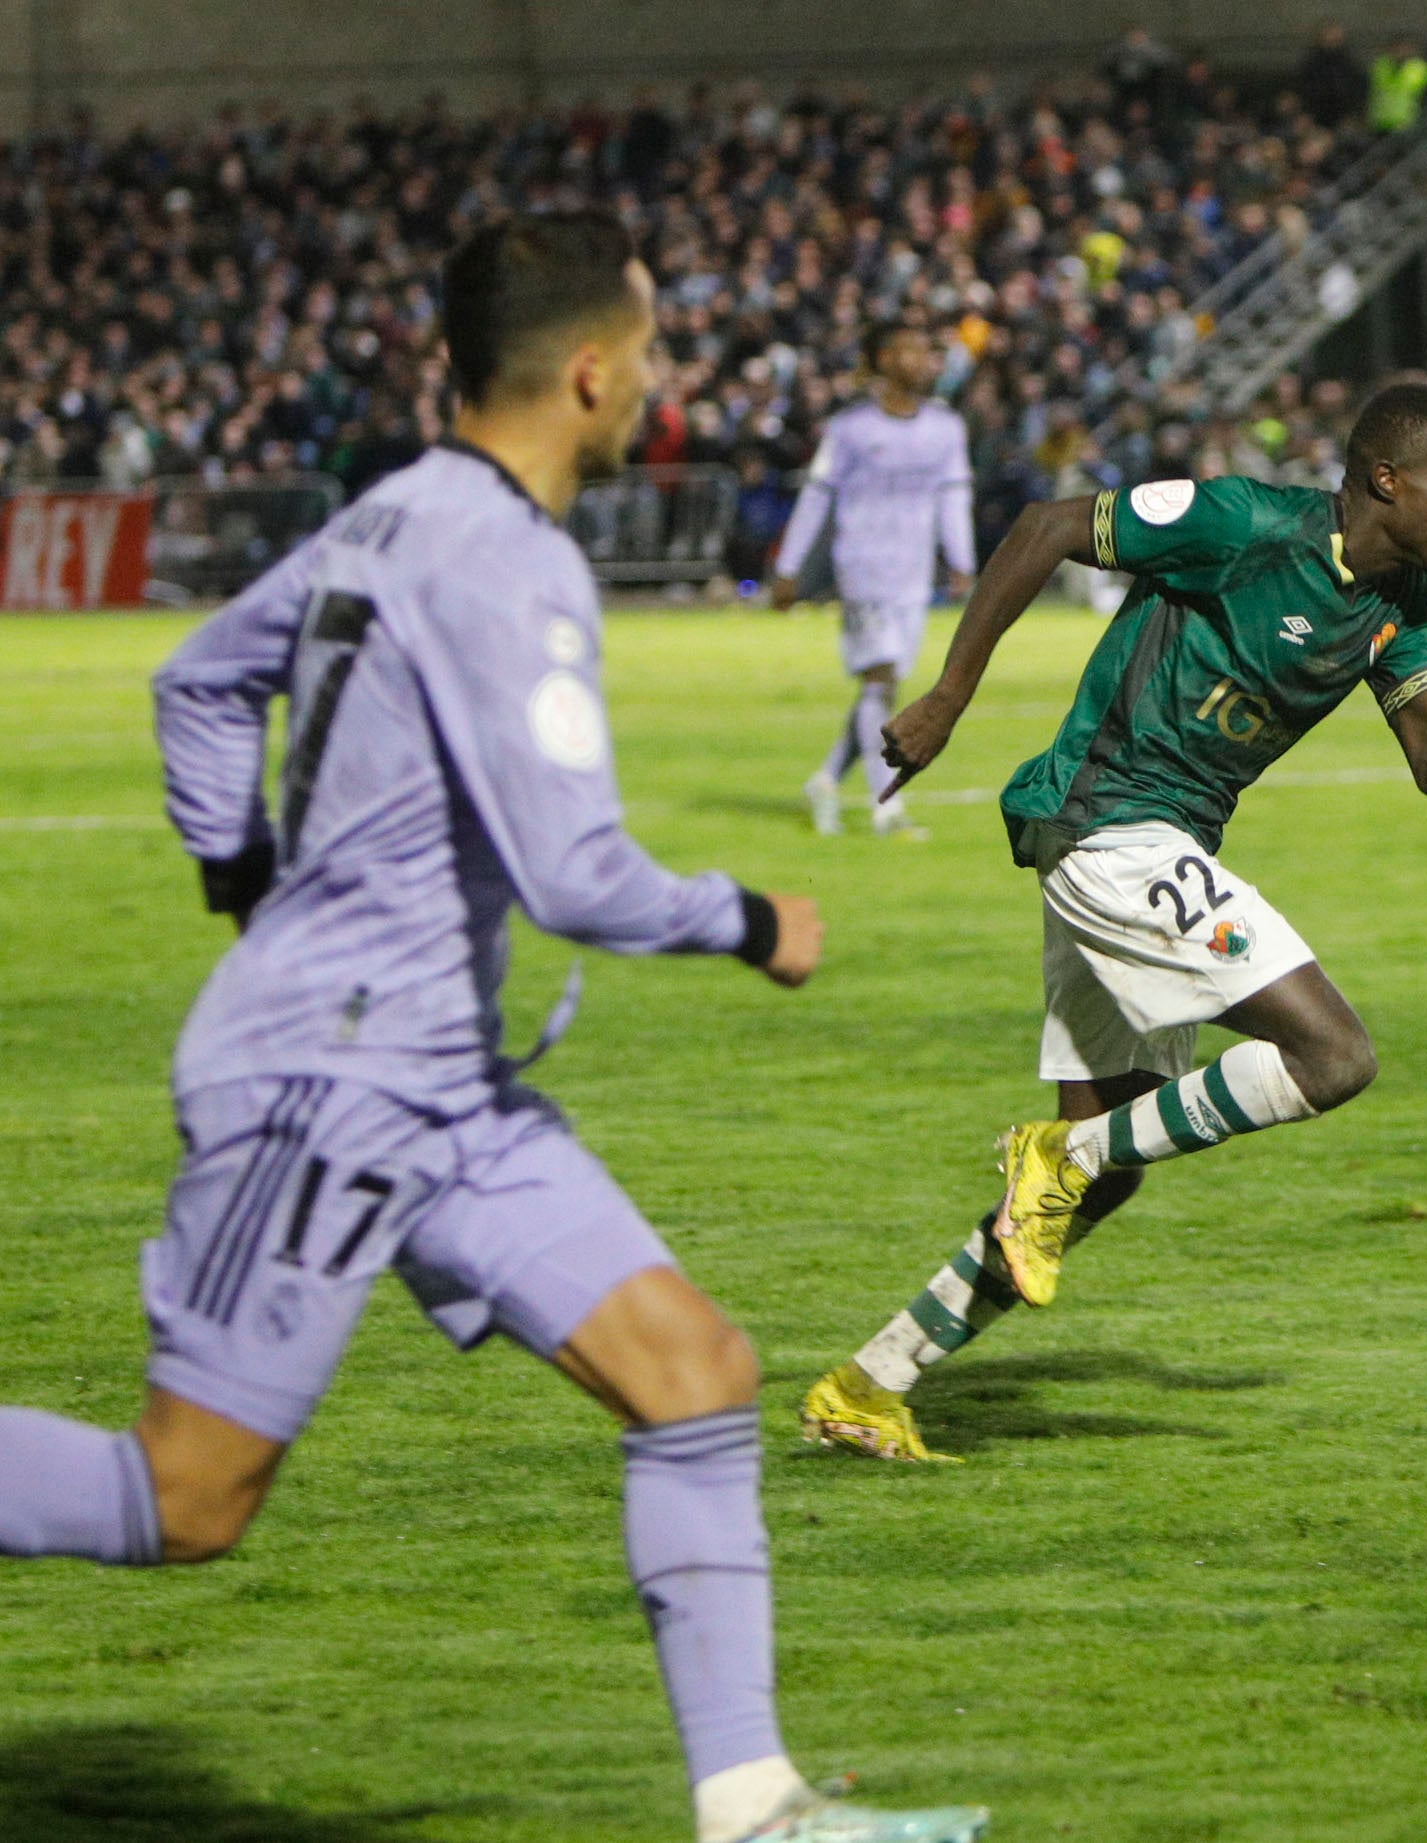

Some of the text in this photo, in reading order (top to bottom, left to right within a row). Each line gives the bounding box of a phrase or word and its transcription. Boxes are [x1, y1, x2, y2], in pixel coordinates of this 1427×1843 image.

[4, 494, 120, 608] REY
[1147, 855, 1234, 935] 22
[271, 1154, 396, 1278] 17
